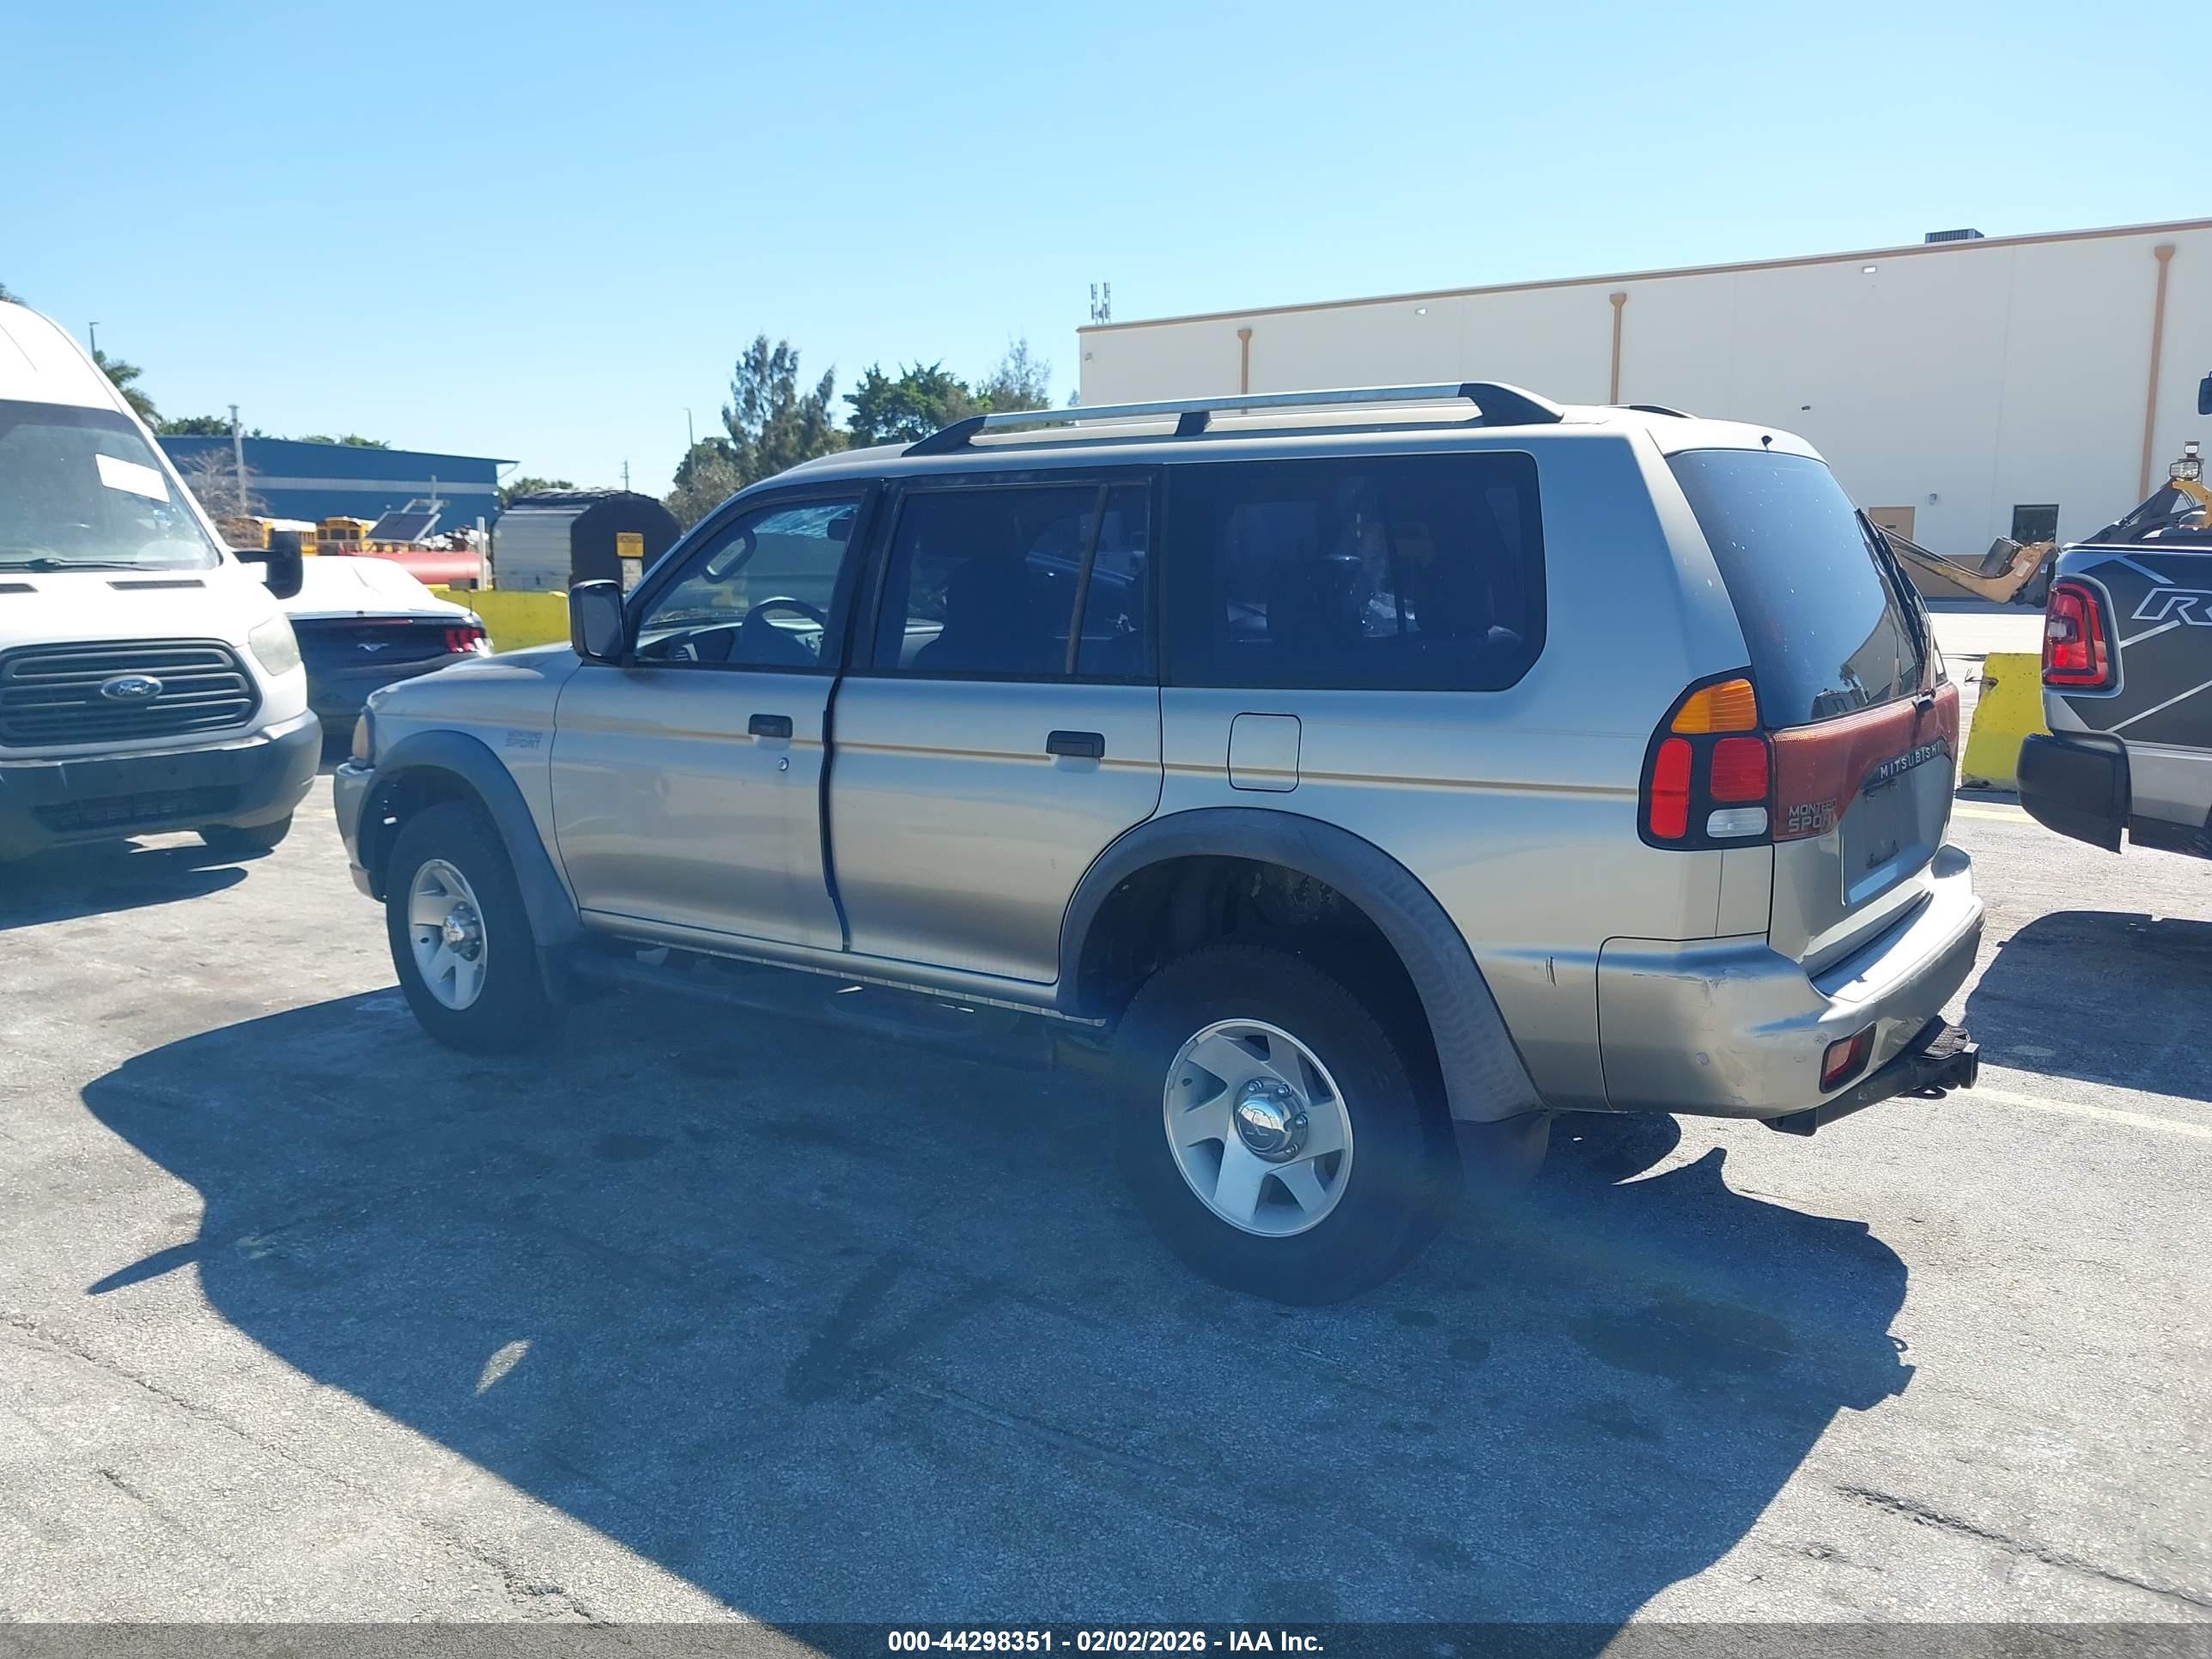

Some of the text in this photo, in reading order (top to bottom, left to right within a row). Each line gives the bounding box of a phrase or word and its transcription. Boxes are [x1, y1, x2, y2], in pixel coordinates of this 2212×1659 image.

[504, 738, 541, 749] SPORT
[1880, 741, 1941, 779] MITSUBISHI
[1789, 797, 1838, 817] MONTERO
